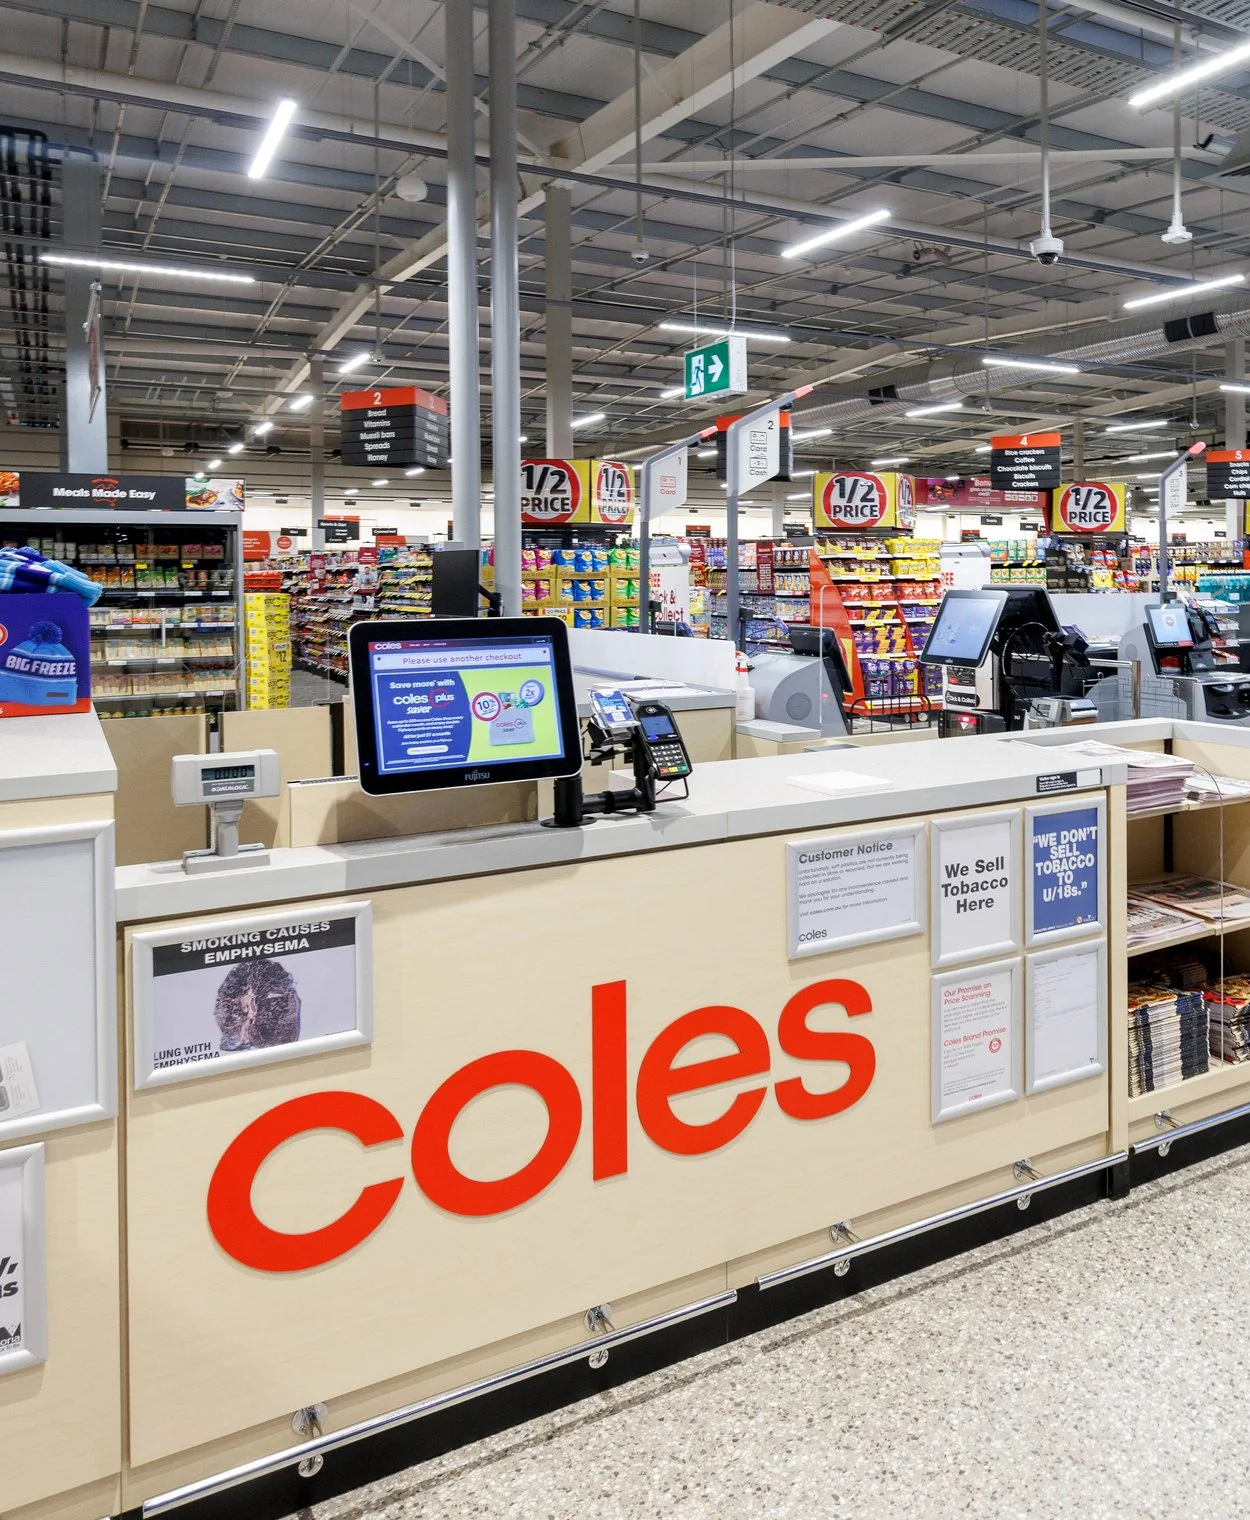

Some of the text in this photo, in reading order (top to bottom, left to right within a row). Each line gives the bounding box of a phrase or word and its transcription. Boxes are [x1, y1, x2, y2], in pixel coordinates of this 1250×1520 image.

[373, 392, 382, 405] 2
[768, 420, 774, 430] 2
[364, 442, 390, 451] Spreads
[1020, 436, 1028, 446] 4
[1236, 451, 1242, 460] 5
[522, 465, 568, 495] 1/2
[603, 468, 625, 497] 1/2
[52, 487, 156, 500] Meals Made Easy
[834, 478, 875, 503] 1/2
[521, 497, 570, 512] PRICE
[1070, 488, 1107, 510] 1/2
[833, 505, 878, 518] PRICE
[1069, 511, 1109, 523] PRICE
[5, 655, 76, 675] BIG FREEZE
[393, 693, 454, 704] coles plus
[406, 706, 432, 714] saver
[465, 771, 490, 781] FUJITSU
[1061, 826, 1097, 844] DON’T
[799, 842, 893, 864] Customer Notice
[1050, 843, 1079, 860] SELL
[945, 856, 1004, 878] We Sell
[1036, 853, 1094, 876] TOBACCO
[1057, 871, 1074, 886] TO
[807, 889, 830, 898] apologise
[848, 880, 881, 890] inconvenience
[942, 877, 1008, 898] Tobacco
[956, 897, 994, 913] Here
[180, 921, 331, 953] SMOKING CAUSES
[799, 929, 827, 942] coles
[204, 938, 310, 964] EMPHYSEMA
[944, 991, 991, 1005] Price Scanning
[957, 985, 982, 995] Promise
[944, 1027, 1006, 1047] Coles Brand Promise
[154, 1042, 211, 1061] LUNG WITH
[206, 978, 876, 1273] coles
